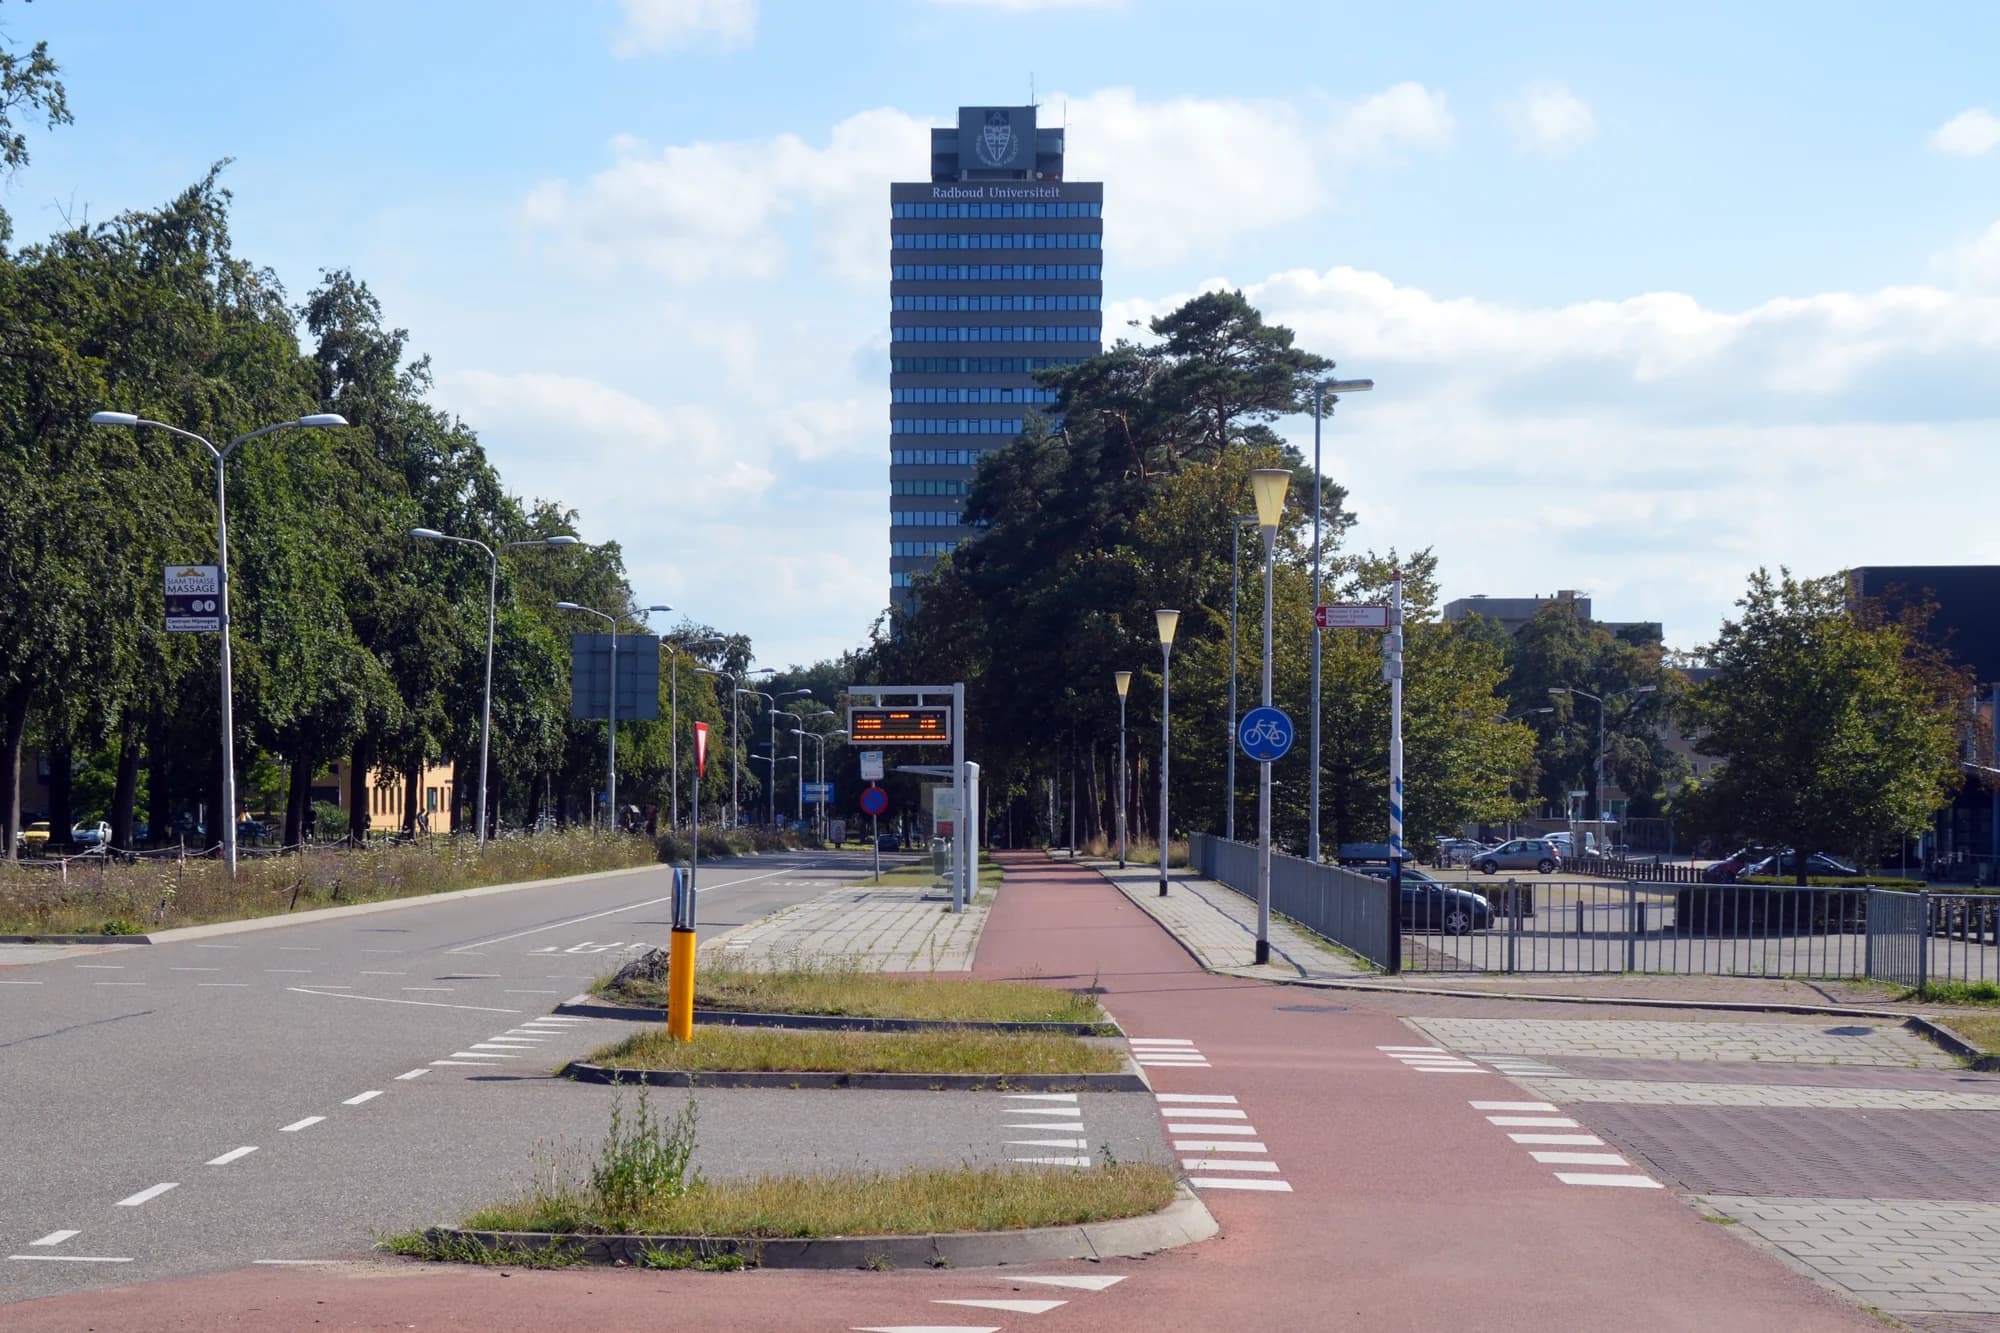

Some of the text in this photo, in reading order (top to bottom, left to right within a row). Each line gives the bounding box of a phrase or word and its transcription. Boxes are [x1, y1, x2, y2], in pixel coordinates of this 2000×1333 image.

[932, 187, 1060, 198] Radboud Universiteit
[167, 577, 215, 585] SIAM THAISE
